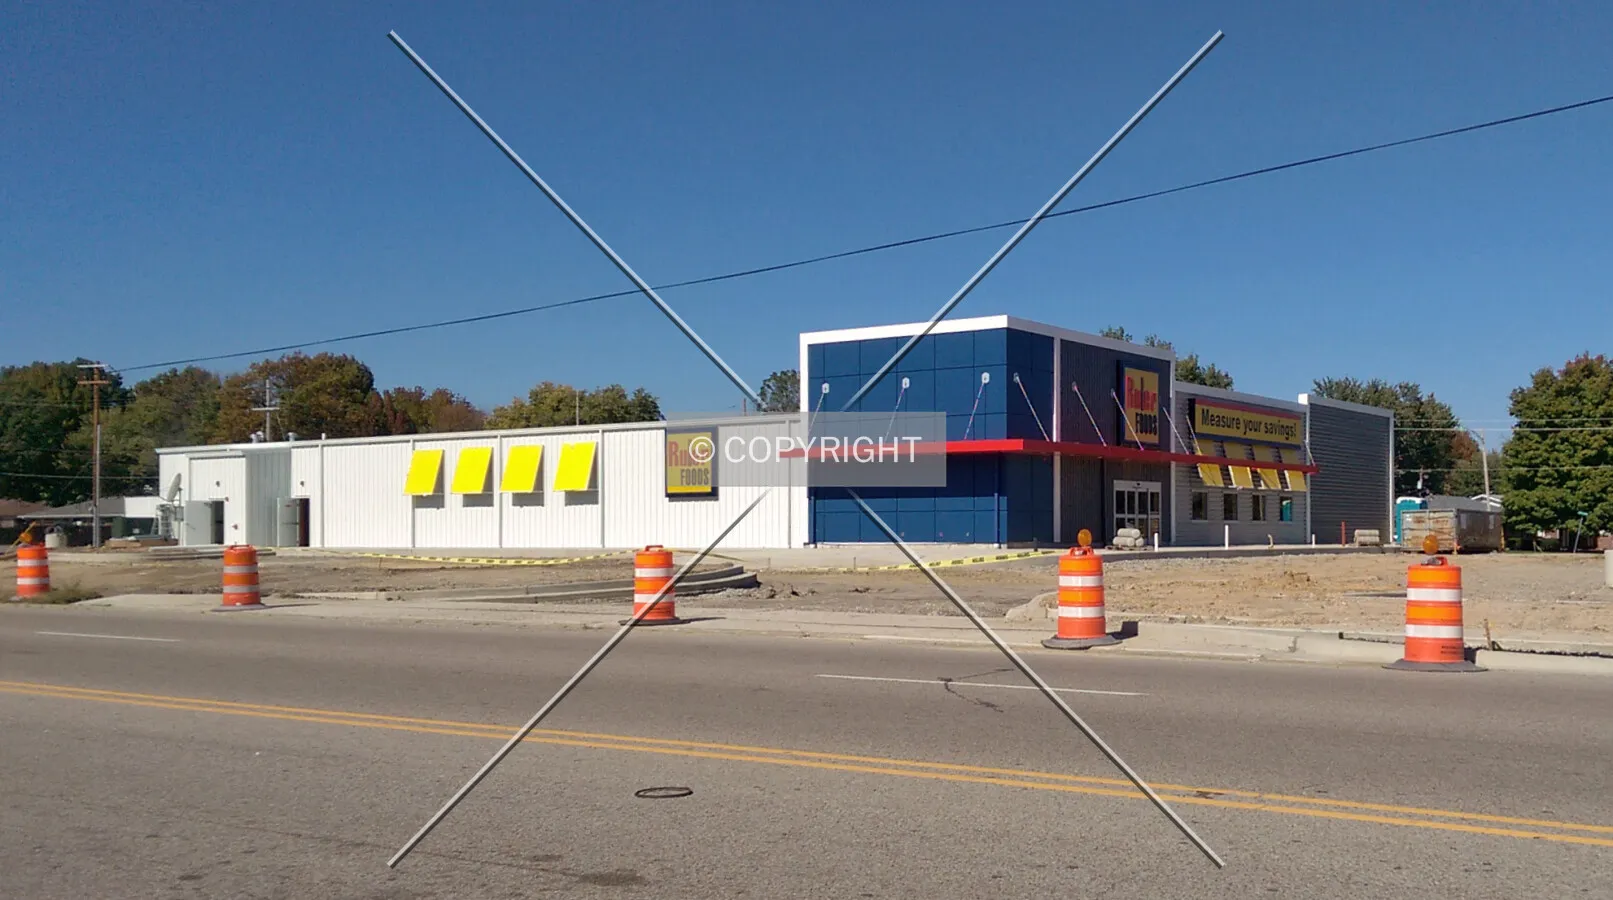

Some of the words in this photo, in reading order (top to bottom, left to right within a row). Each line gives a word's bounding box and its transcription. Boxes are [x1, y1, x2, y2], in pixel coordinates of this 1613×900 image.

[1126, 376, 1157, 412] Ruler
[1136, 412, 1157, 436] FOODS
[1201, 408, 1241, 430] Measure
[1243, 419, 1262, 435] your
[1264, 419, 1297, 440] savings!
[680, 468, 709, 486] FOODS
